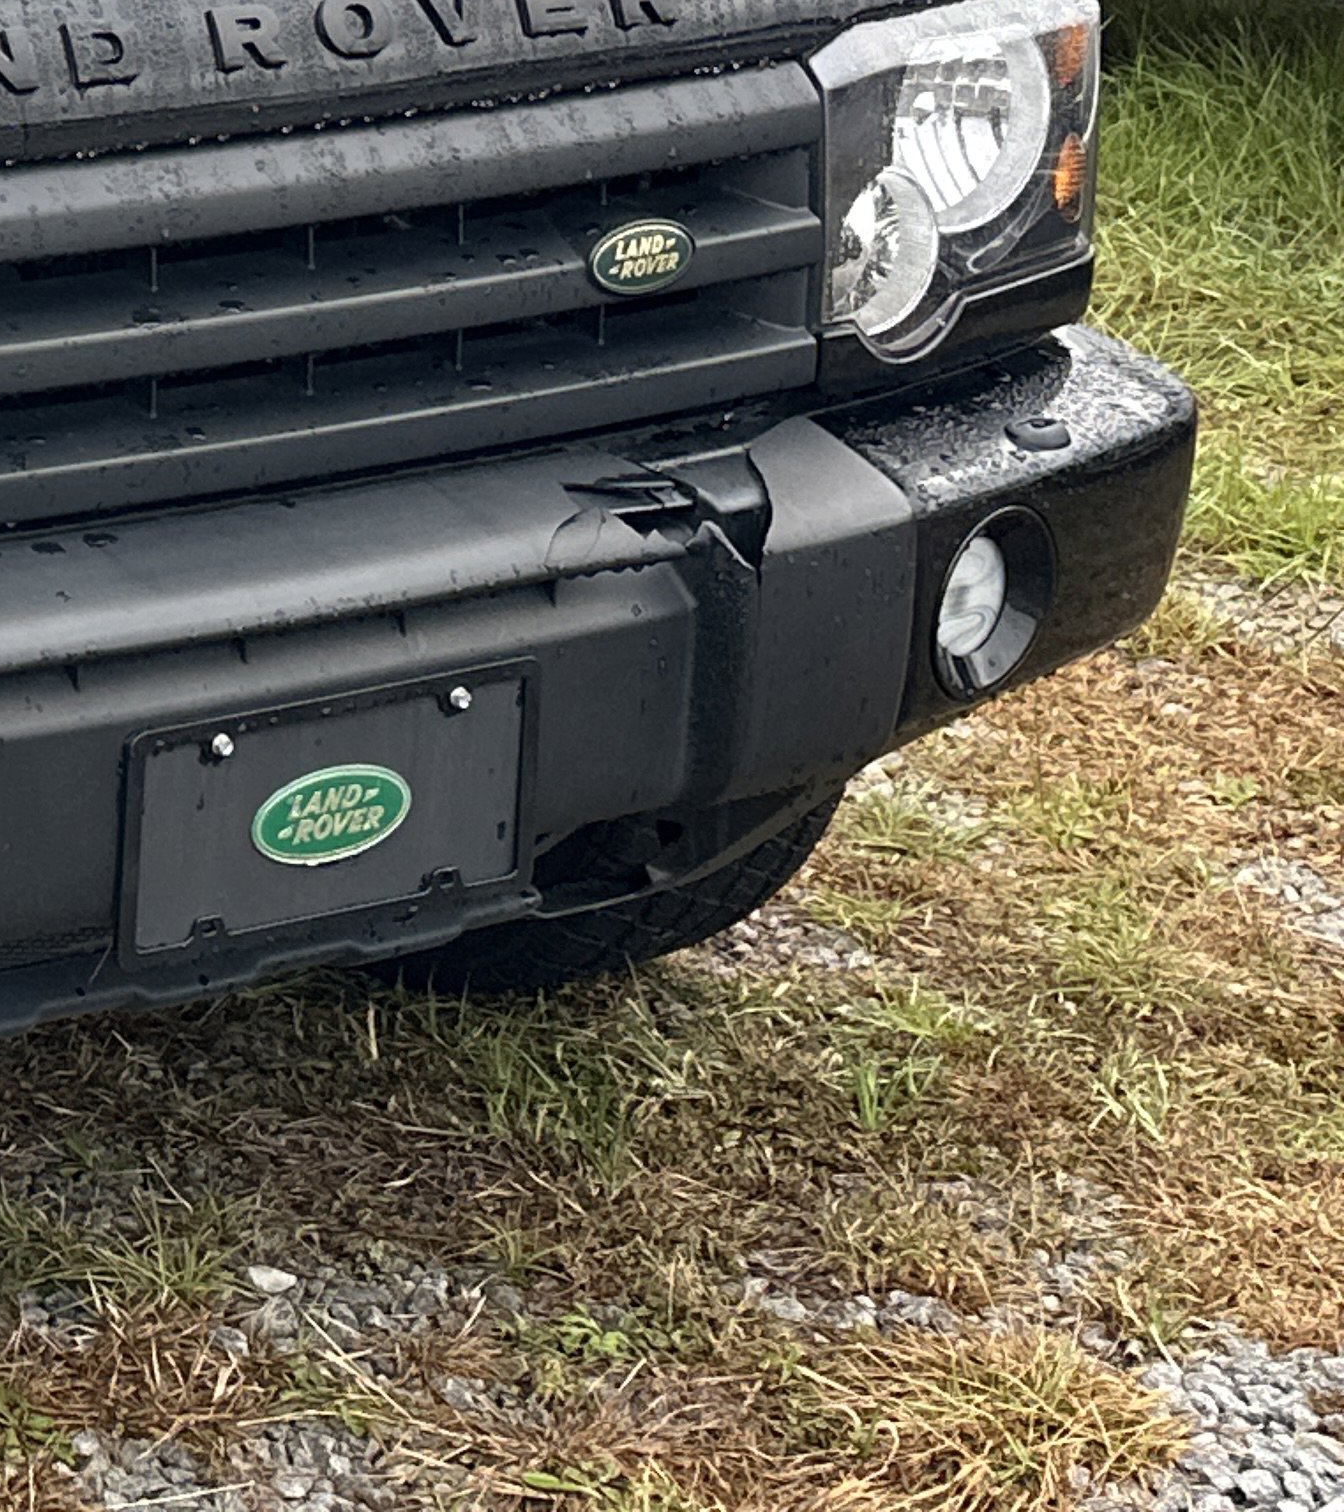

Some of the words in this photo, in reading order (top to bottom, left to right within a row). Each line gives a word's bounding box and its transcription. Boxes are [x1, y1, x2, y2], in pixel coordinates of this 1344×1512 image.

[615, 234, 665, 261] LAND
[619, 252, 680, 280] ROVER
[287, 783, 363, 821] LAND
[292, 805, 385, 846] ROVER
